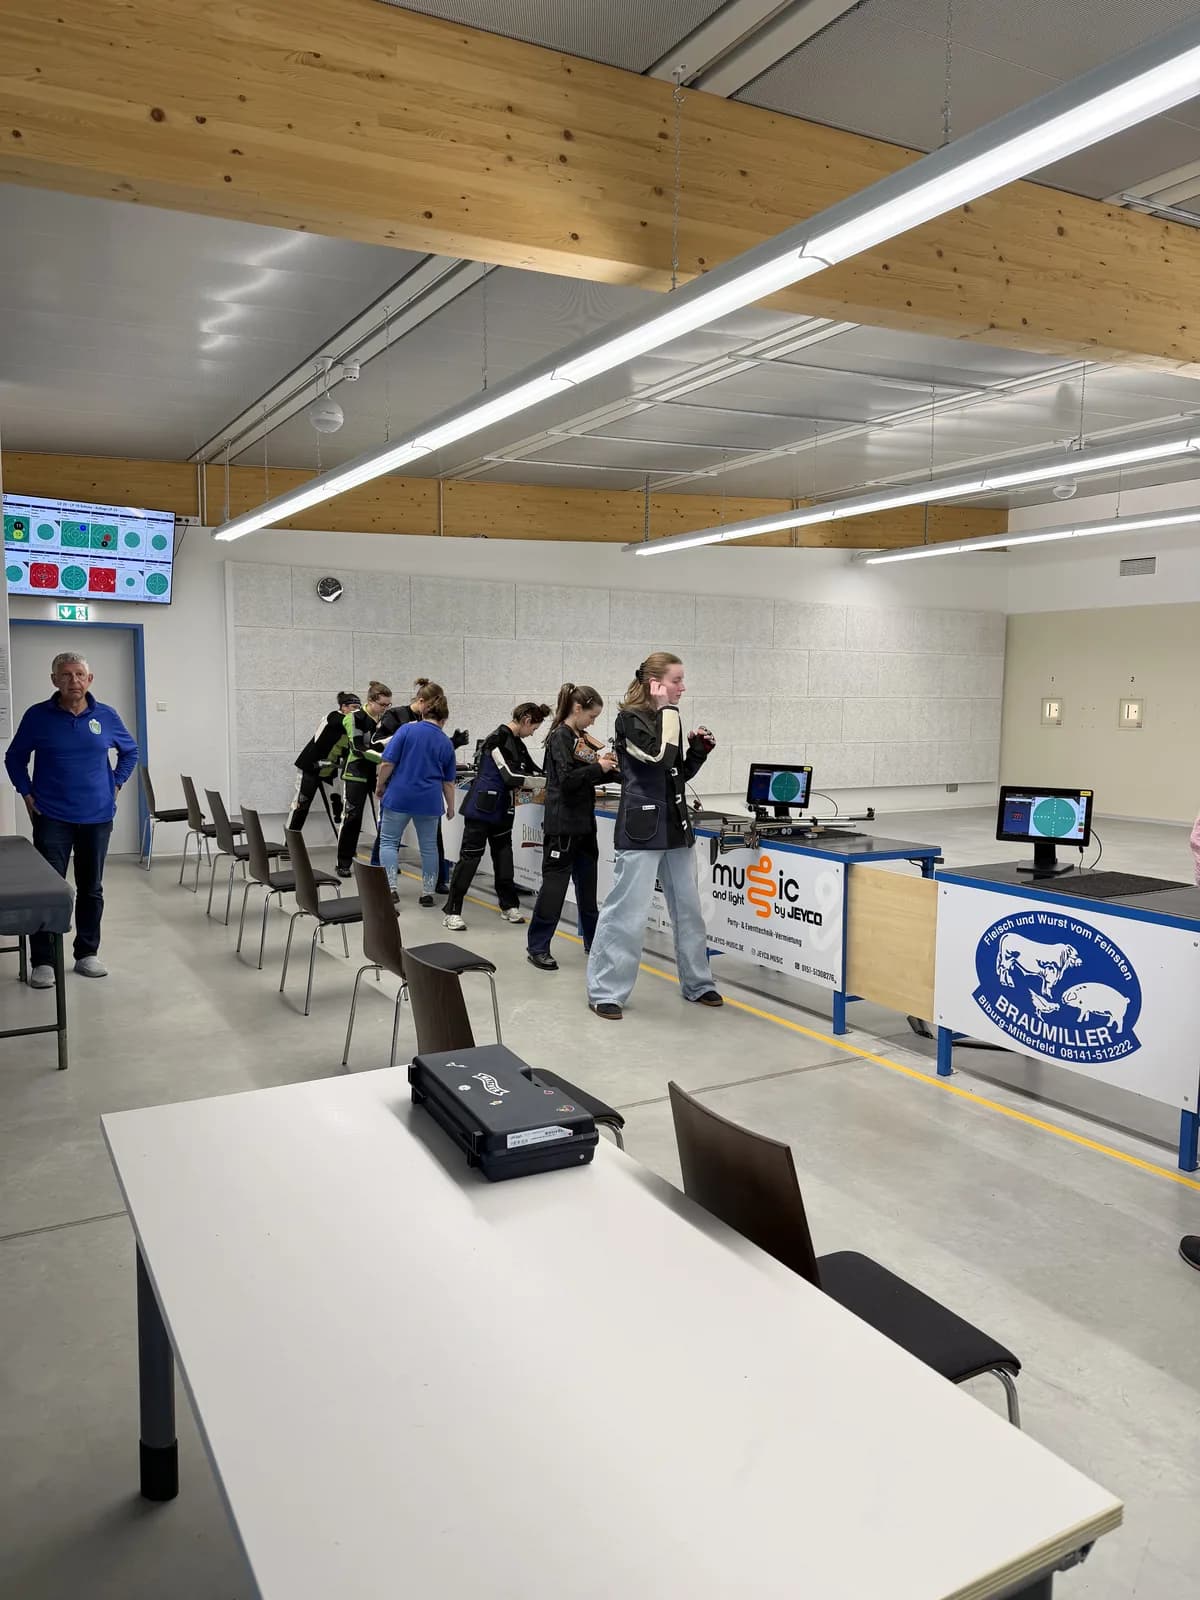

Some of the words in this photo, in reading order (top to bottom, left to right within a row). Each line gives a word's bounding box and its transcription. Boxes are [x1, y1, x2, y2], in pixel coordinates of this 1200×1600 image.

[712, 890, 727, 901] and
[728, 891, 745, 906] light
[774, 902, 786, 919] by
[787, 906, 823, 927] JEYCO
[983, 919, 1015, 946] Fleisch
[1016, 914, 1035, 926] und
[1037, 914, 1068, 929] Wurst
[1070, 922, 1093, 940] vom
[1094, 935, 1133, 981] Feinsten
[978, 994, 1056, 1055] Biburg-Mitterfeld
[1060, 1039, 1133, 1061] 08141-512222
[995, 995, 1112, 1047] BRAUMILLER
